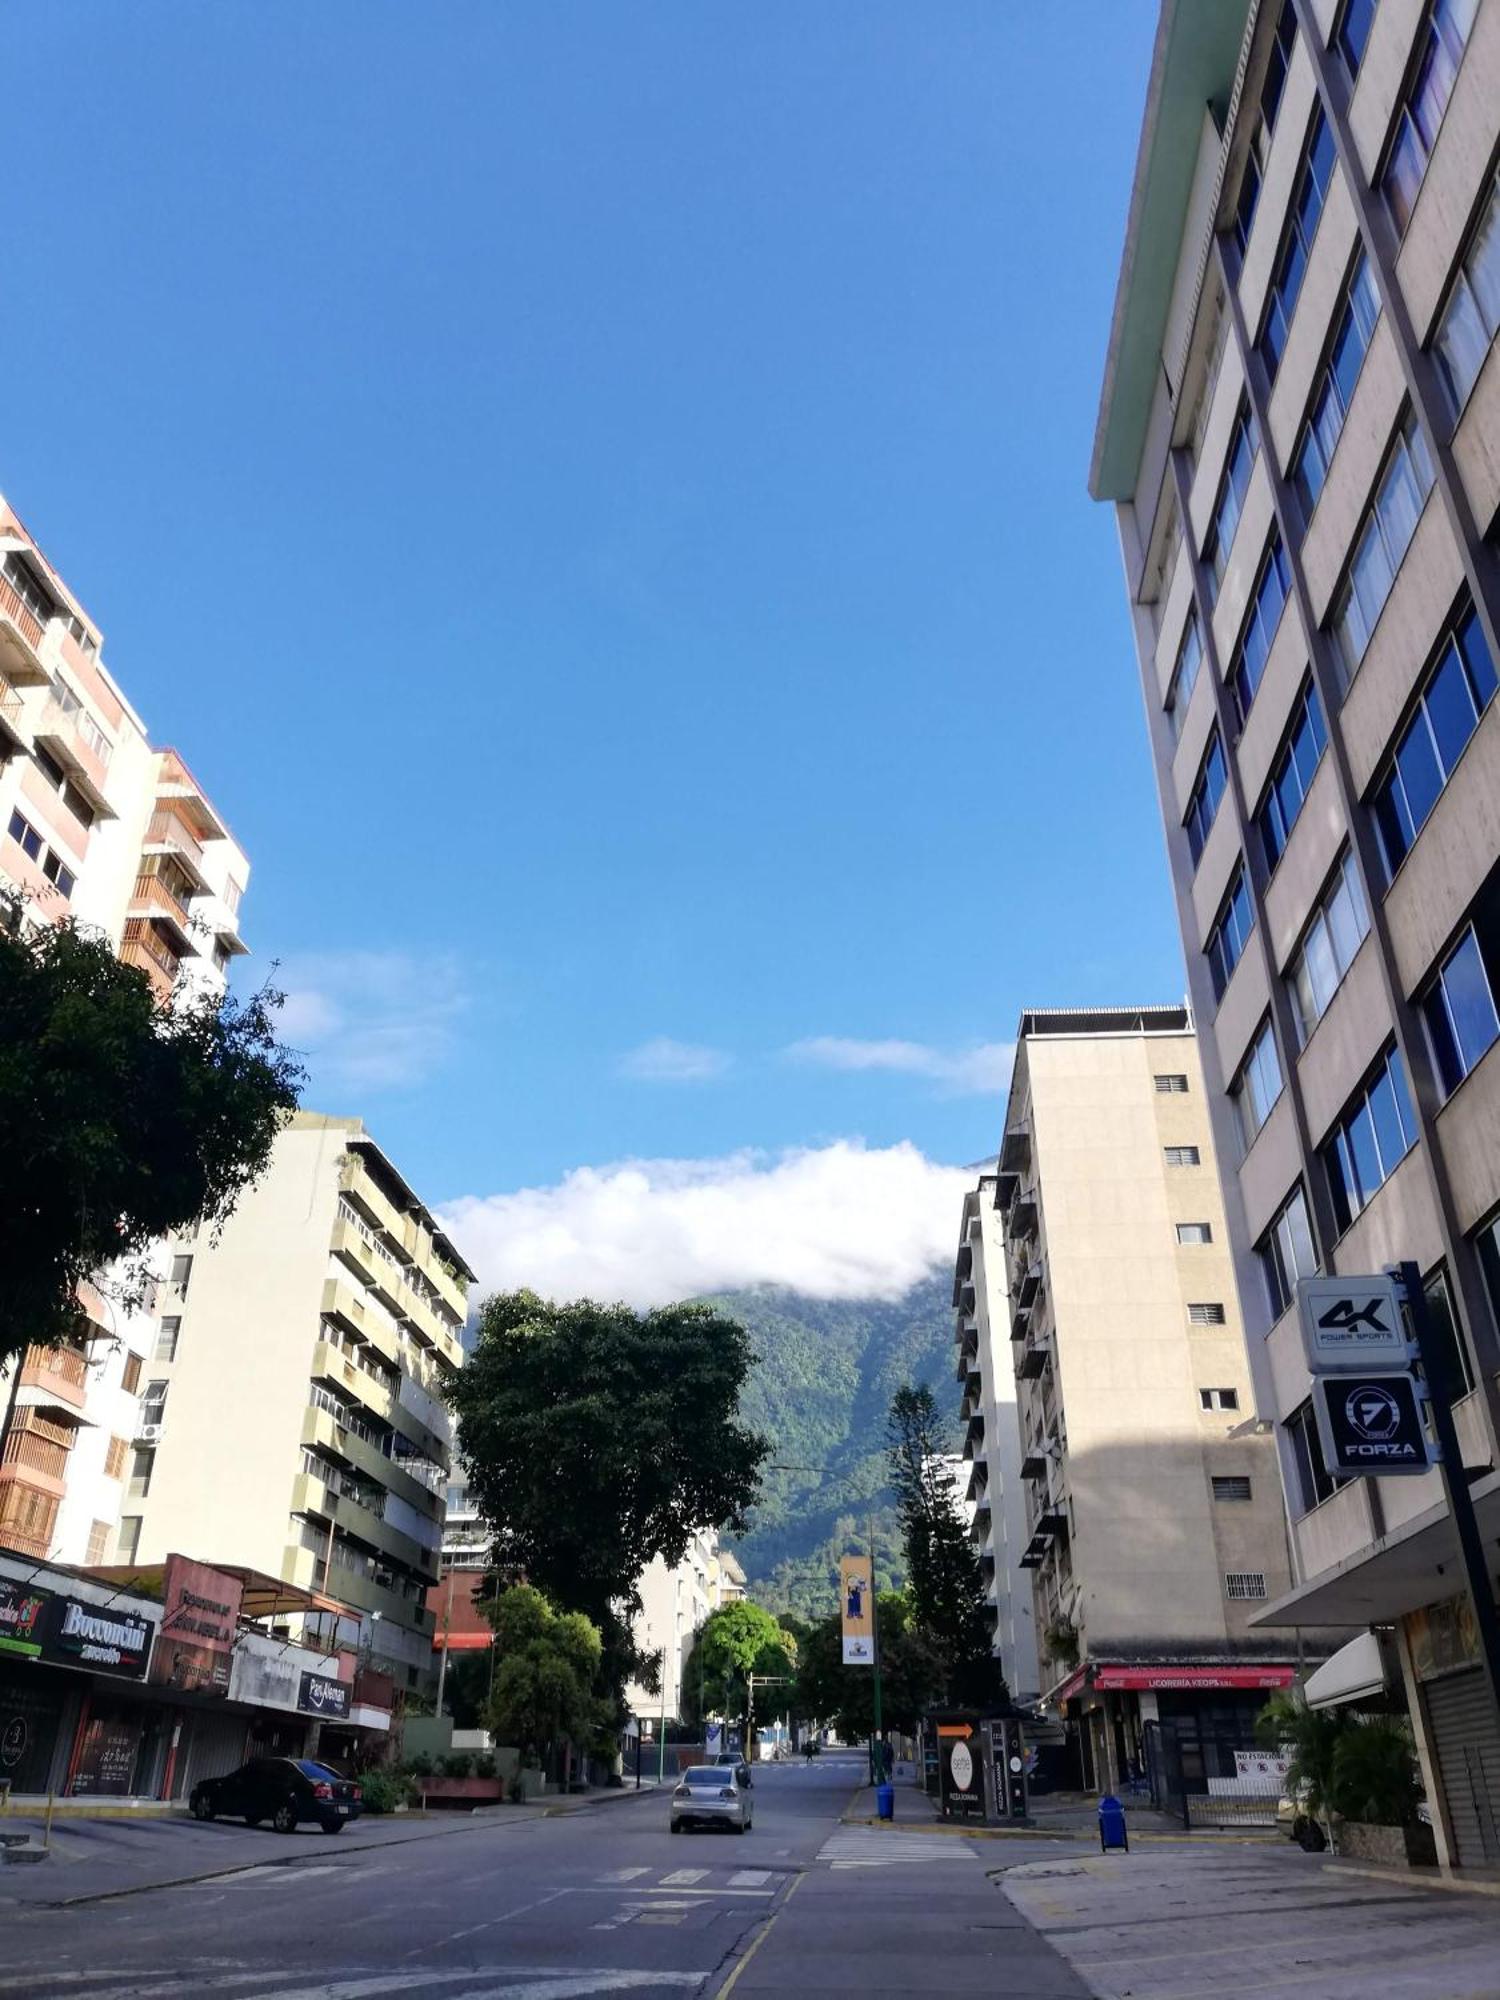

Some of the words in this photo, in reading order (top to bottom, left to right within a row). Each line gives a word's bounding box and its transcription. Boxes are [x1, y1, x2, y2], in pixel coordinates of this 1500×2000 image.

[1318, 1298, 1391, 1332] 4K
[1320, 1333, 1353, 1341] POWER
[1356, 1332, 1393, 1341] SPORTS
[1345, 1443, 1417, 1456] FORZA
